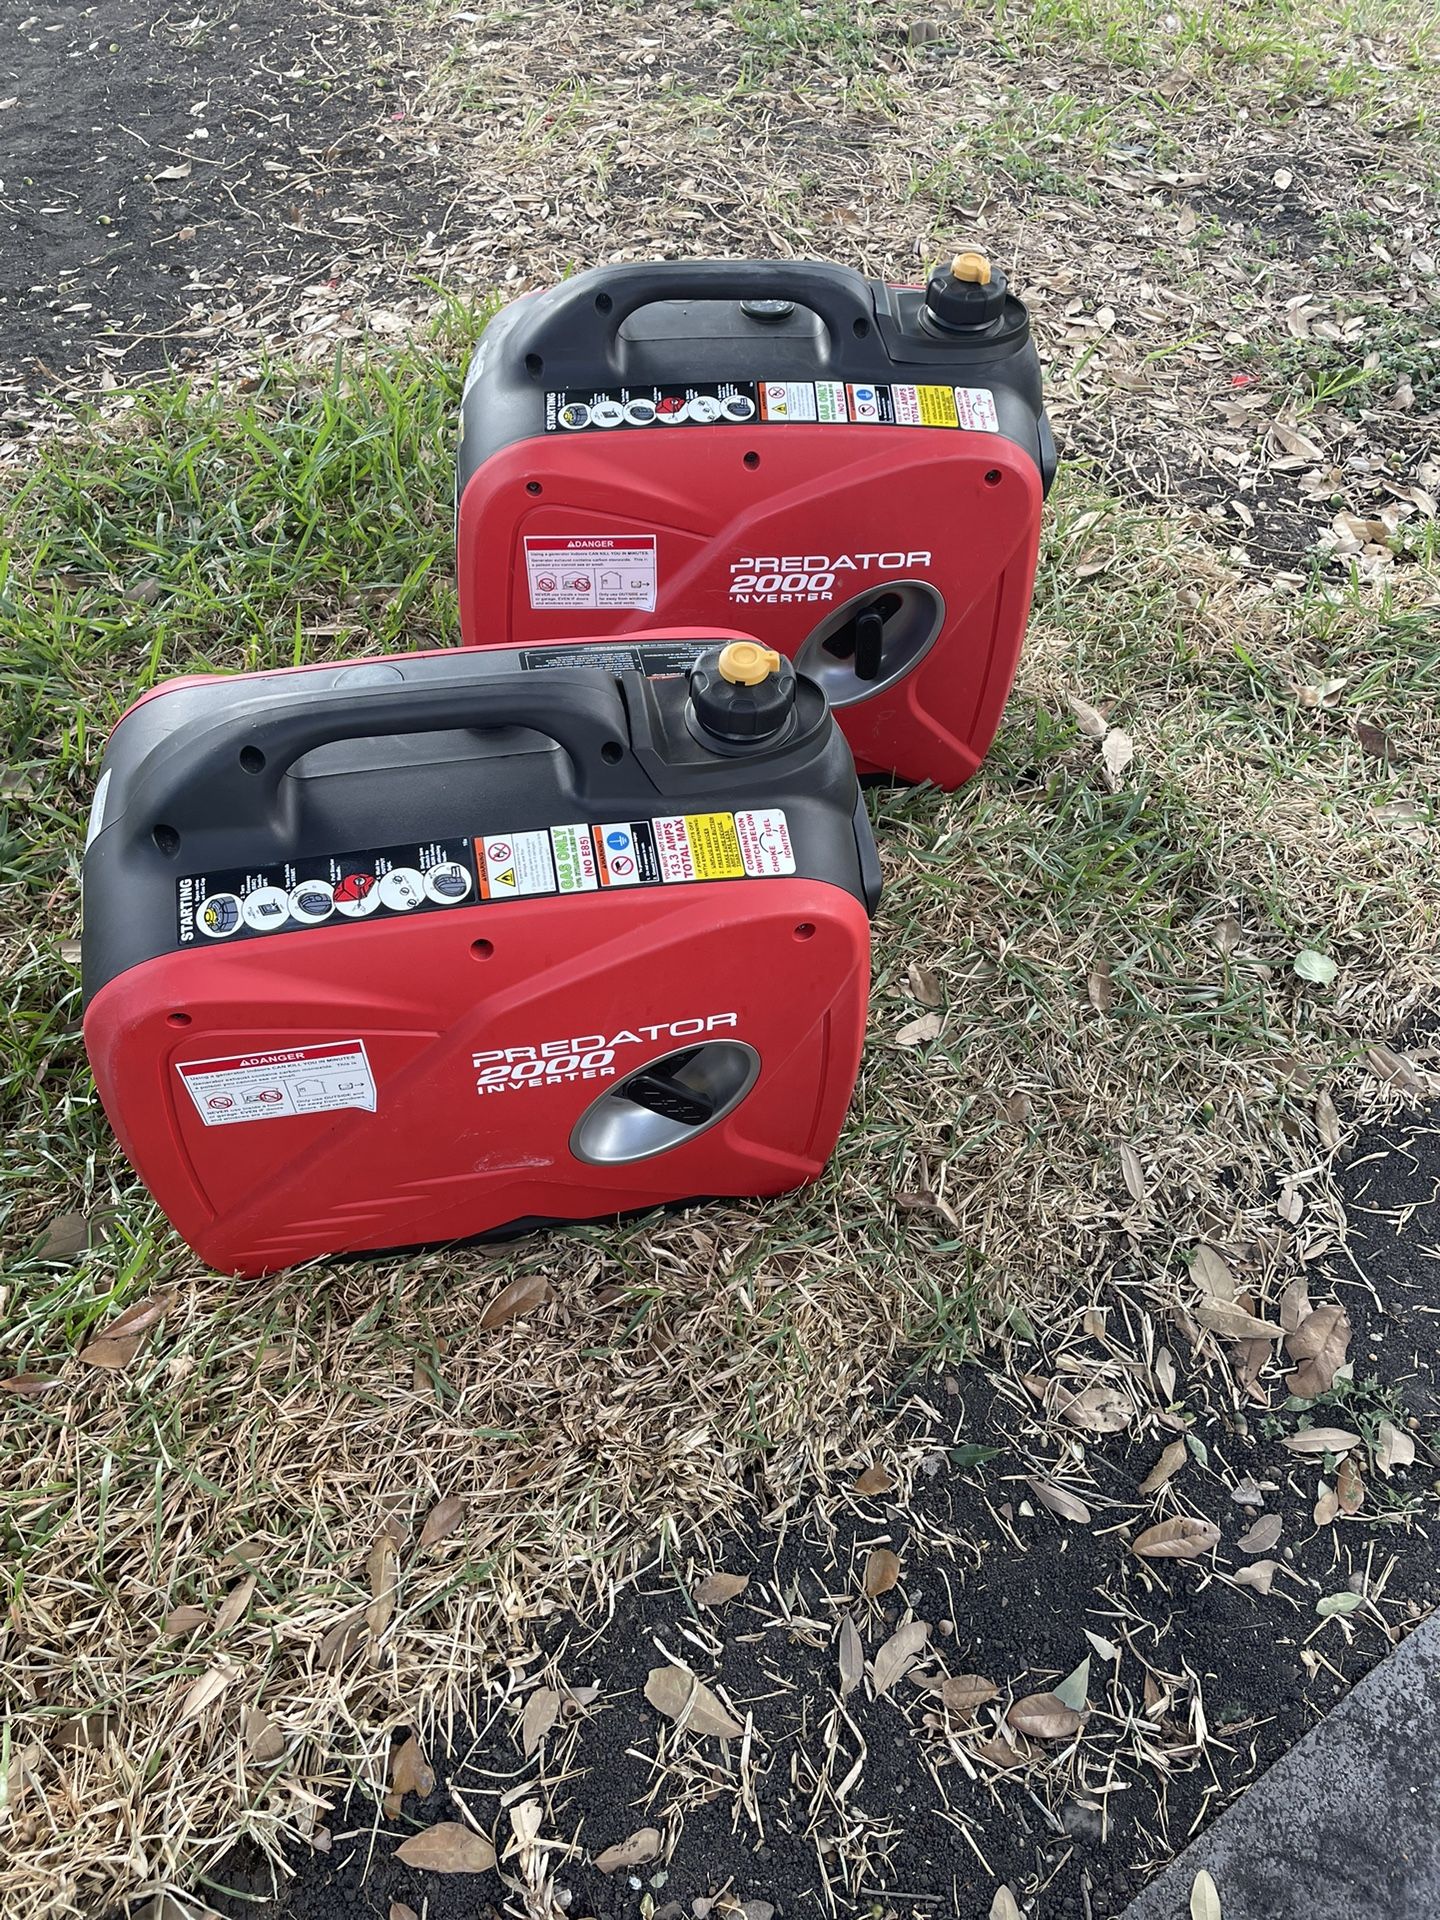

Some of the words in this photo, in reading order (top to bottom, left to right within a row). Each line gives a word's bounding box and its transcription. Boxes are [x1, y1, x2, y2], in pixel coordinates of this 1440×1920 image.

[898, 388, 908, 405] AMPS
[907, 386, 916, 400] MAX
[545, 392, 556, 430] STARTING
[909, 401, 919, 423] TOTAL
[729, 551, 932, 573] PREDATOR
[729, 573, 836, 593] 2000
[729, 592, 833, 603] NVERTER
[654, 820, 663, 840] EXCEED
[662, 822, 677, 851] AMPS
[673, 818, 686, 841] MAX
[745, 813, 757, 841] BELOW
[762, 817, 773, 837] FUEL
[552, 828, 570, 860] ONLY
[578, 835, 592, 856] E85)
[737, 817, 754, 870] COMBINATION
[778, 823, 791, 858] IGNITION
[478, 851, 486, 877] WARNING
[582, 858, 595, 876] (NO
[660, 852, 668, 867] MUST
[668, 853, 681, 876] 13.3
[678, 844, 693, 878] TOTAL
[693, 849, 701, 867] POWER
[751, 843, 764, 873] SWITCH
[768, 845, 780, 872] CHOKE
[557, 863, 575, 889] GAS
[663, 868, 671, 879] YOU
[472, 1012, 738, 1068] PREDATOR
[248, 1051, 305, 1066] DANGER
[476, 1049, 616, 1086] 2000
[477, 1066, 616, 1095] INVERTER
